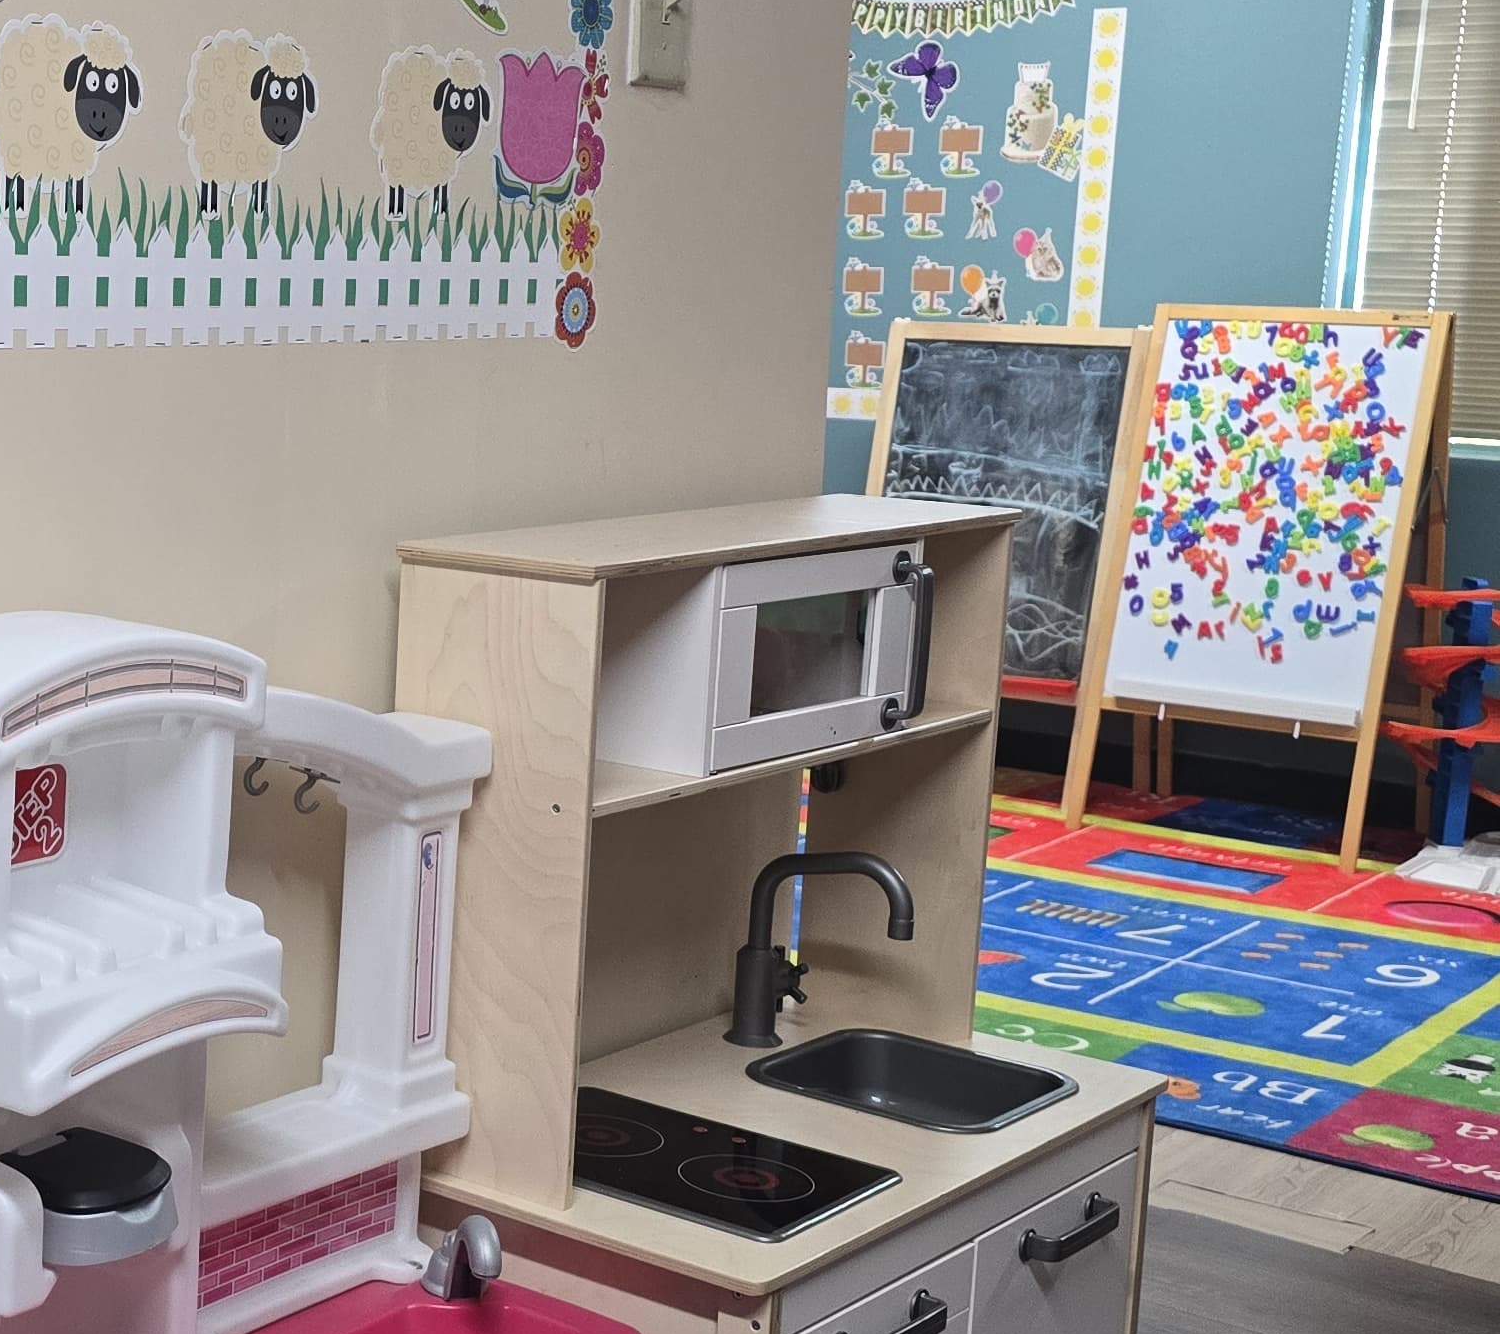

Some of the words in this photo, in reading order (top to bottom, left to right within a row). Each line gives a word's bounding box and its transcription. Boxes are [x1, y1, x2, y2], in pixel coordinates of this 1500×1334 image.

[1115, 924, 1187, 945] 7
[1030, 962, 1115, 990] 2
[1212, 1070, 1328, 1105] Bb
